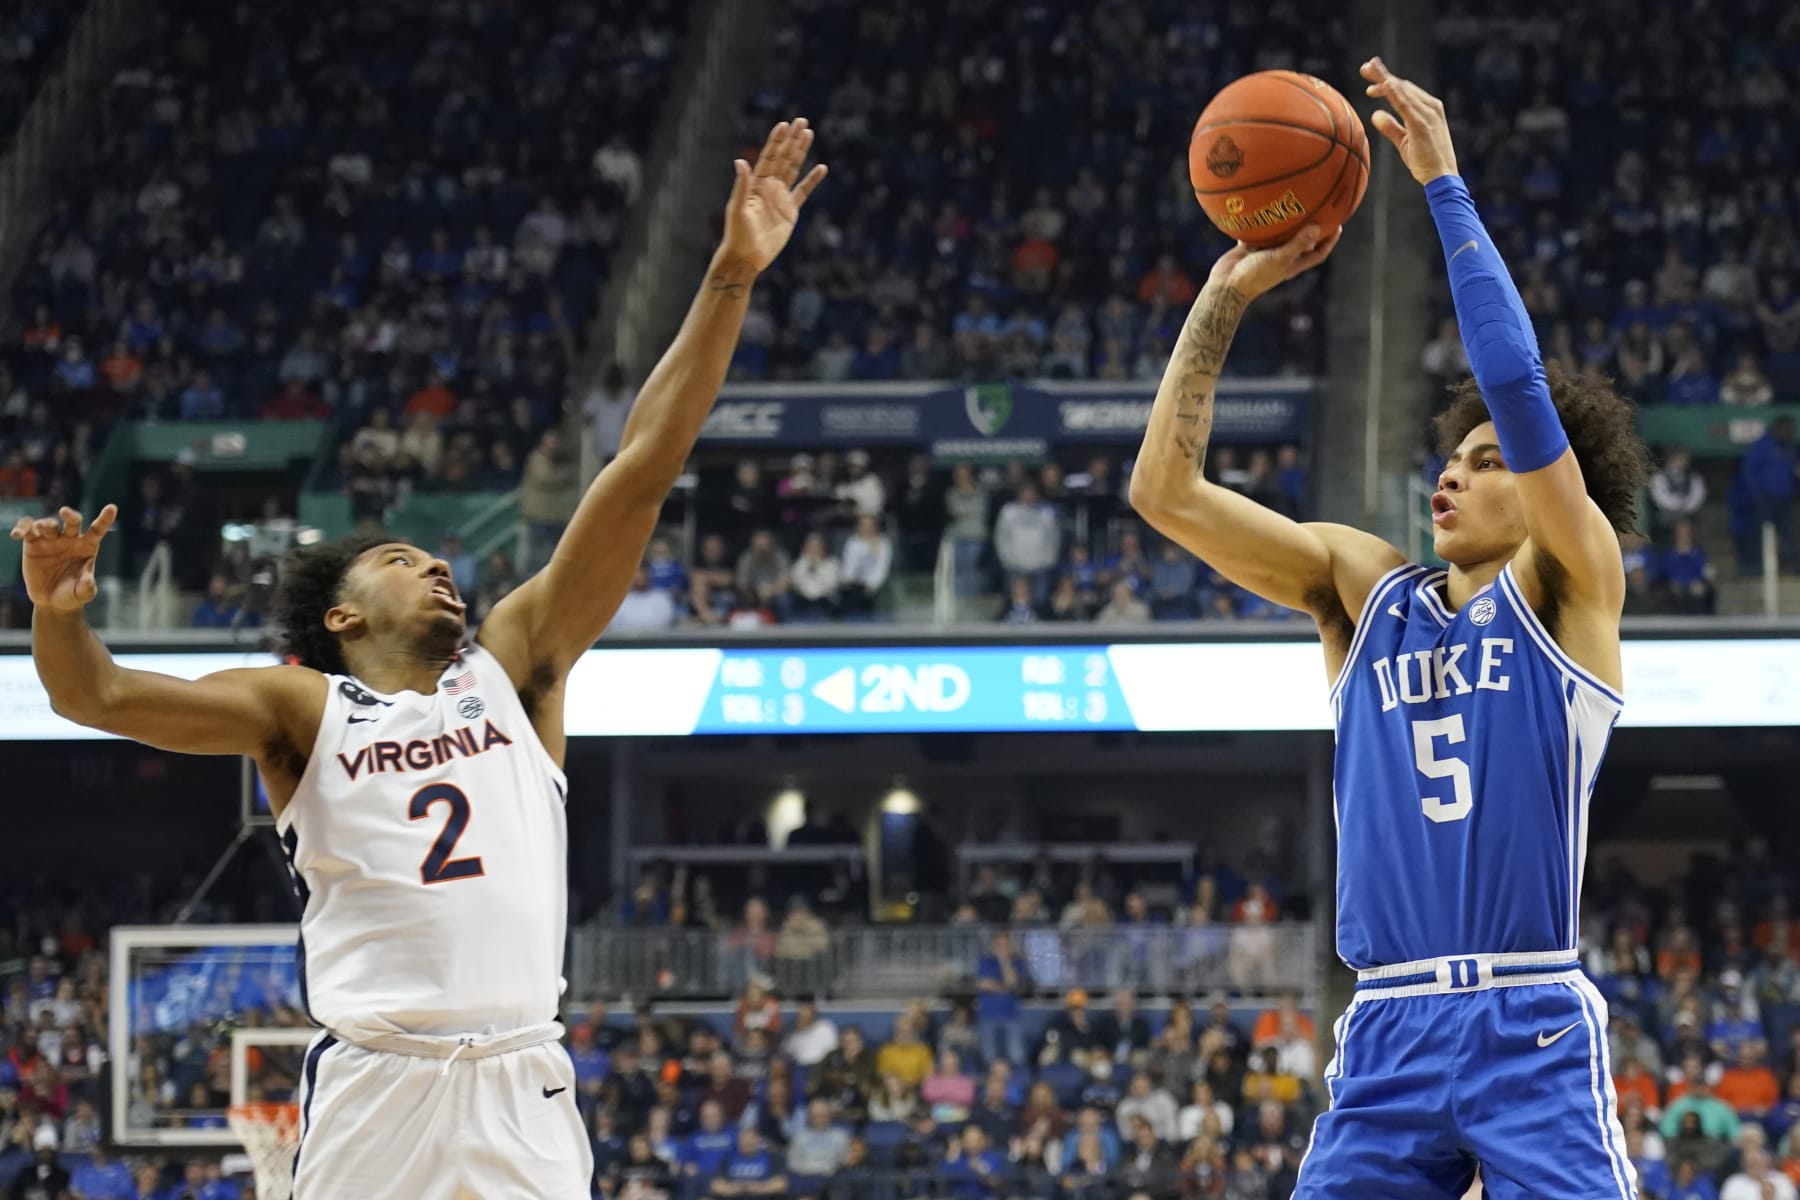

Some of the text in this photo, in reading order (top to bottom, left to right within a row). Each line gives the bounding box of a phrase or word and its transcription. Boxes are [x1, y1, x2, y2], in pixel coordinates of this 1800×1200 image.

[781, 655, 807, 689] 0
[860, 663, 971, 713] 2ND
[1084, 653, 1109, 687] 2
[1373, 638, 1513, 712] DUKE
[782, 692, 806, 725] 3
[1084, 689, 1109, 723] 3
[337, 719, 512, 781] VIRGINIA
[1412, 713, 1473, 823] 5
[408, 782, 485, 885] 2
[1448, 959, 1480, 988] D
